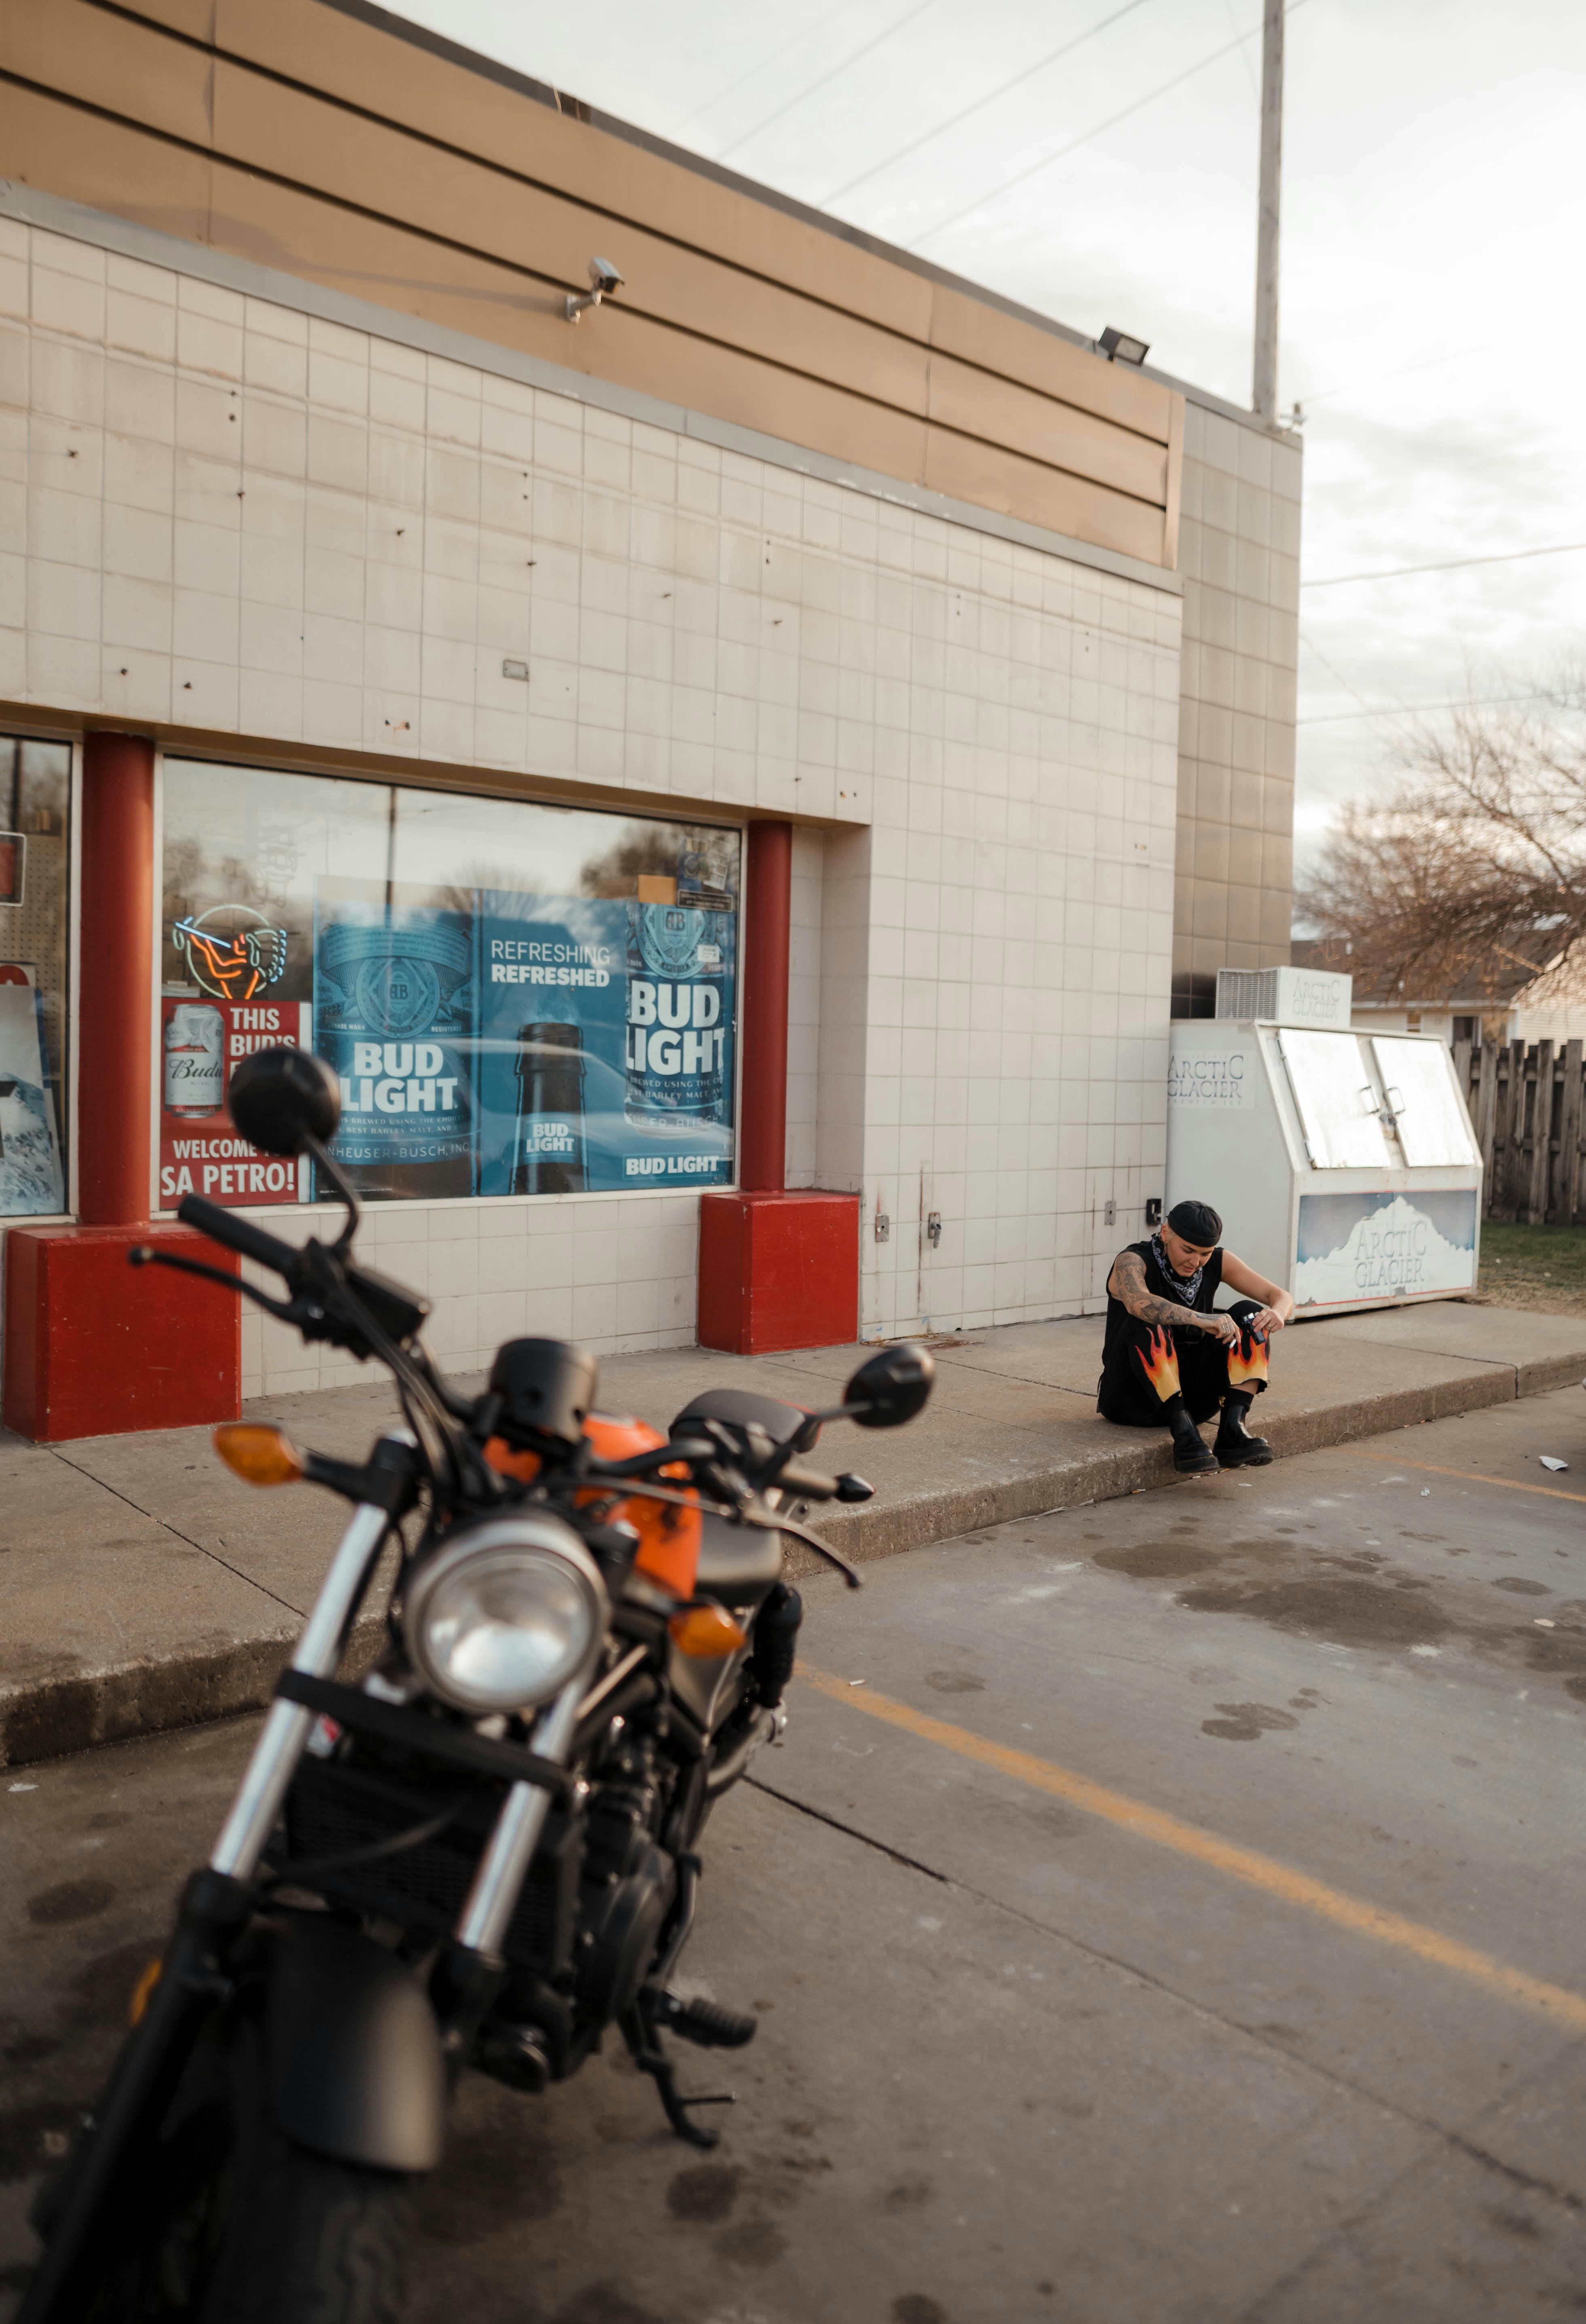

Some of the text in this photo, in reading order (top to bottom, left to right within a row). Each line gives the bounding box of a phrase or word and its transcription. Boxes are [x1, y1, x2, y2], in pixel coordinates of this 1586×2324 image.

[491, 940, 610, 964] REFRESHING
[491, 964, 610, 987] REFRESHED
[1293, 976, 1340, 1002] ARCTIC
[631, 980, 720, 1029] BUD
[1293, 998, 1338, 1019] GLACIER
[230, 1007, 280, 1031] THIS
[354, 1042, 444, 1077] BUD
[1168, 1055, 1243, 1080] ARCTIC
[339, 1077, 458, 1113] LIGHT
[646, 1091, 682, 1100] BARLEY
[1168, 1080, 1243, 1099] GLACIER
[533, 1123, 569, 1138] BUD
[172, 1138, 257, 1159] WELCOME
[526, 1138, 574, 1153] LIGHT
[626, 1156, 720, 1176] BUD LIGHT
[161, 1162, 294, 1196] SA PETRO!
[1354, 1220, 1427, 1260] ARCTIC
[1355, 1258, 1424, 1288] GLACIER
